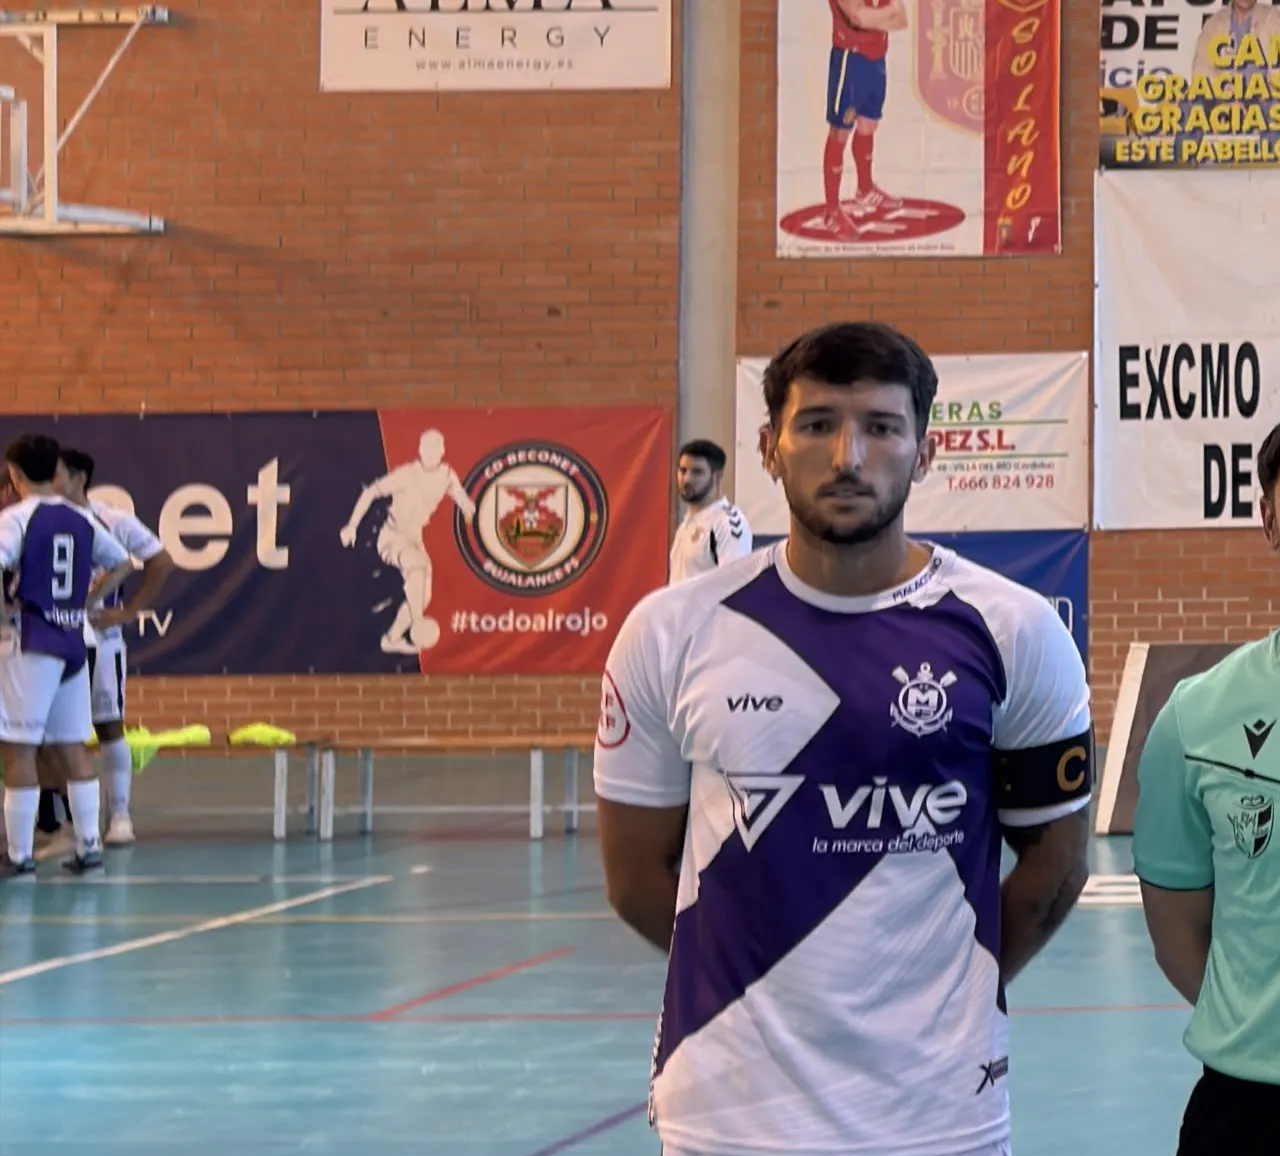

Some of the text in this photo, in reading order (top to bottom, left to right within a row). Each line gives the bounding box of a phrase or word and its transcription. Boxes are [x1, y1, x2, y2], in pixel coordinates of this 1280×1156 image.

[364, 26, 611, 49] ENERGY
[1102, 14, 1179, 50] DE
[1115, 139, 1176, 163] ESTE
[1118, 340, 1262, 421] EXCMO
[932, 401, 1003, 420] ERAS
[929, 428, 1016, 452] PEZ S.L.
[507, 449, 580, 476] BECONET
[992, 476, 1020, 490] 824
[1026, 474, 1054, 489] 928
[1203, 442, 1254, 519] DE
[51, 534, 74, 600] 9
[137, 609, 173, 636] TV
[451, 607, 608, 636] #todoalrojo
[726, 693, 784, 713] vive
[1057, 746, 1086, 791] C
[818, 775, 968, 830] vive
[813, 836, 829, 853] la
[832, 836, 884, 853] marca
